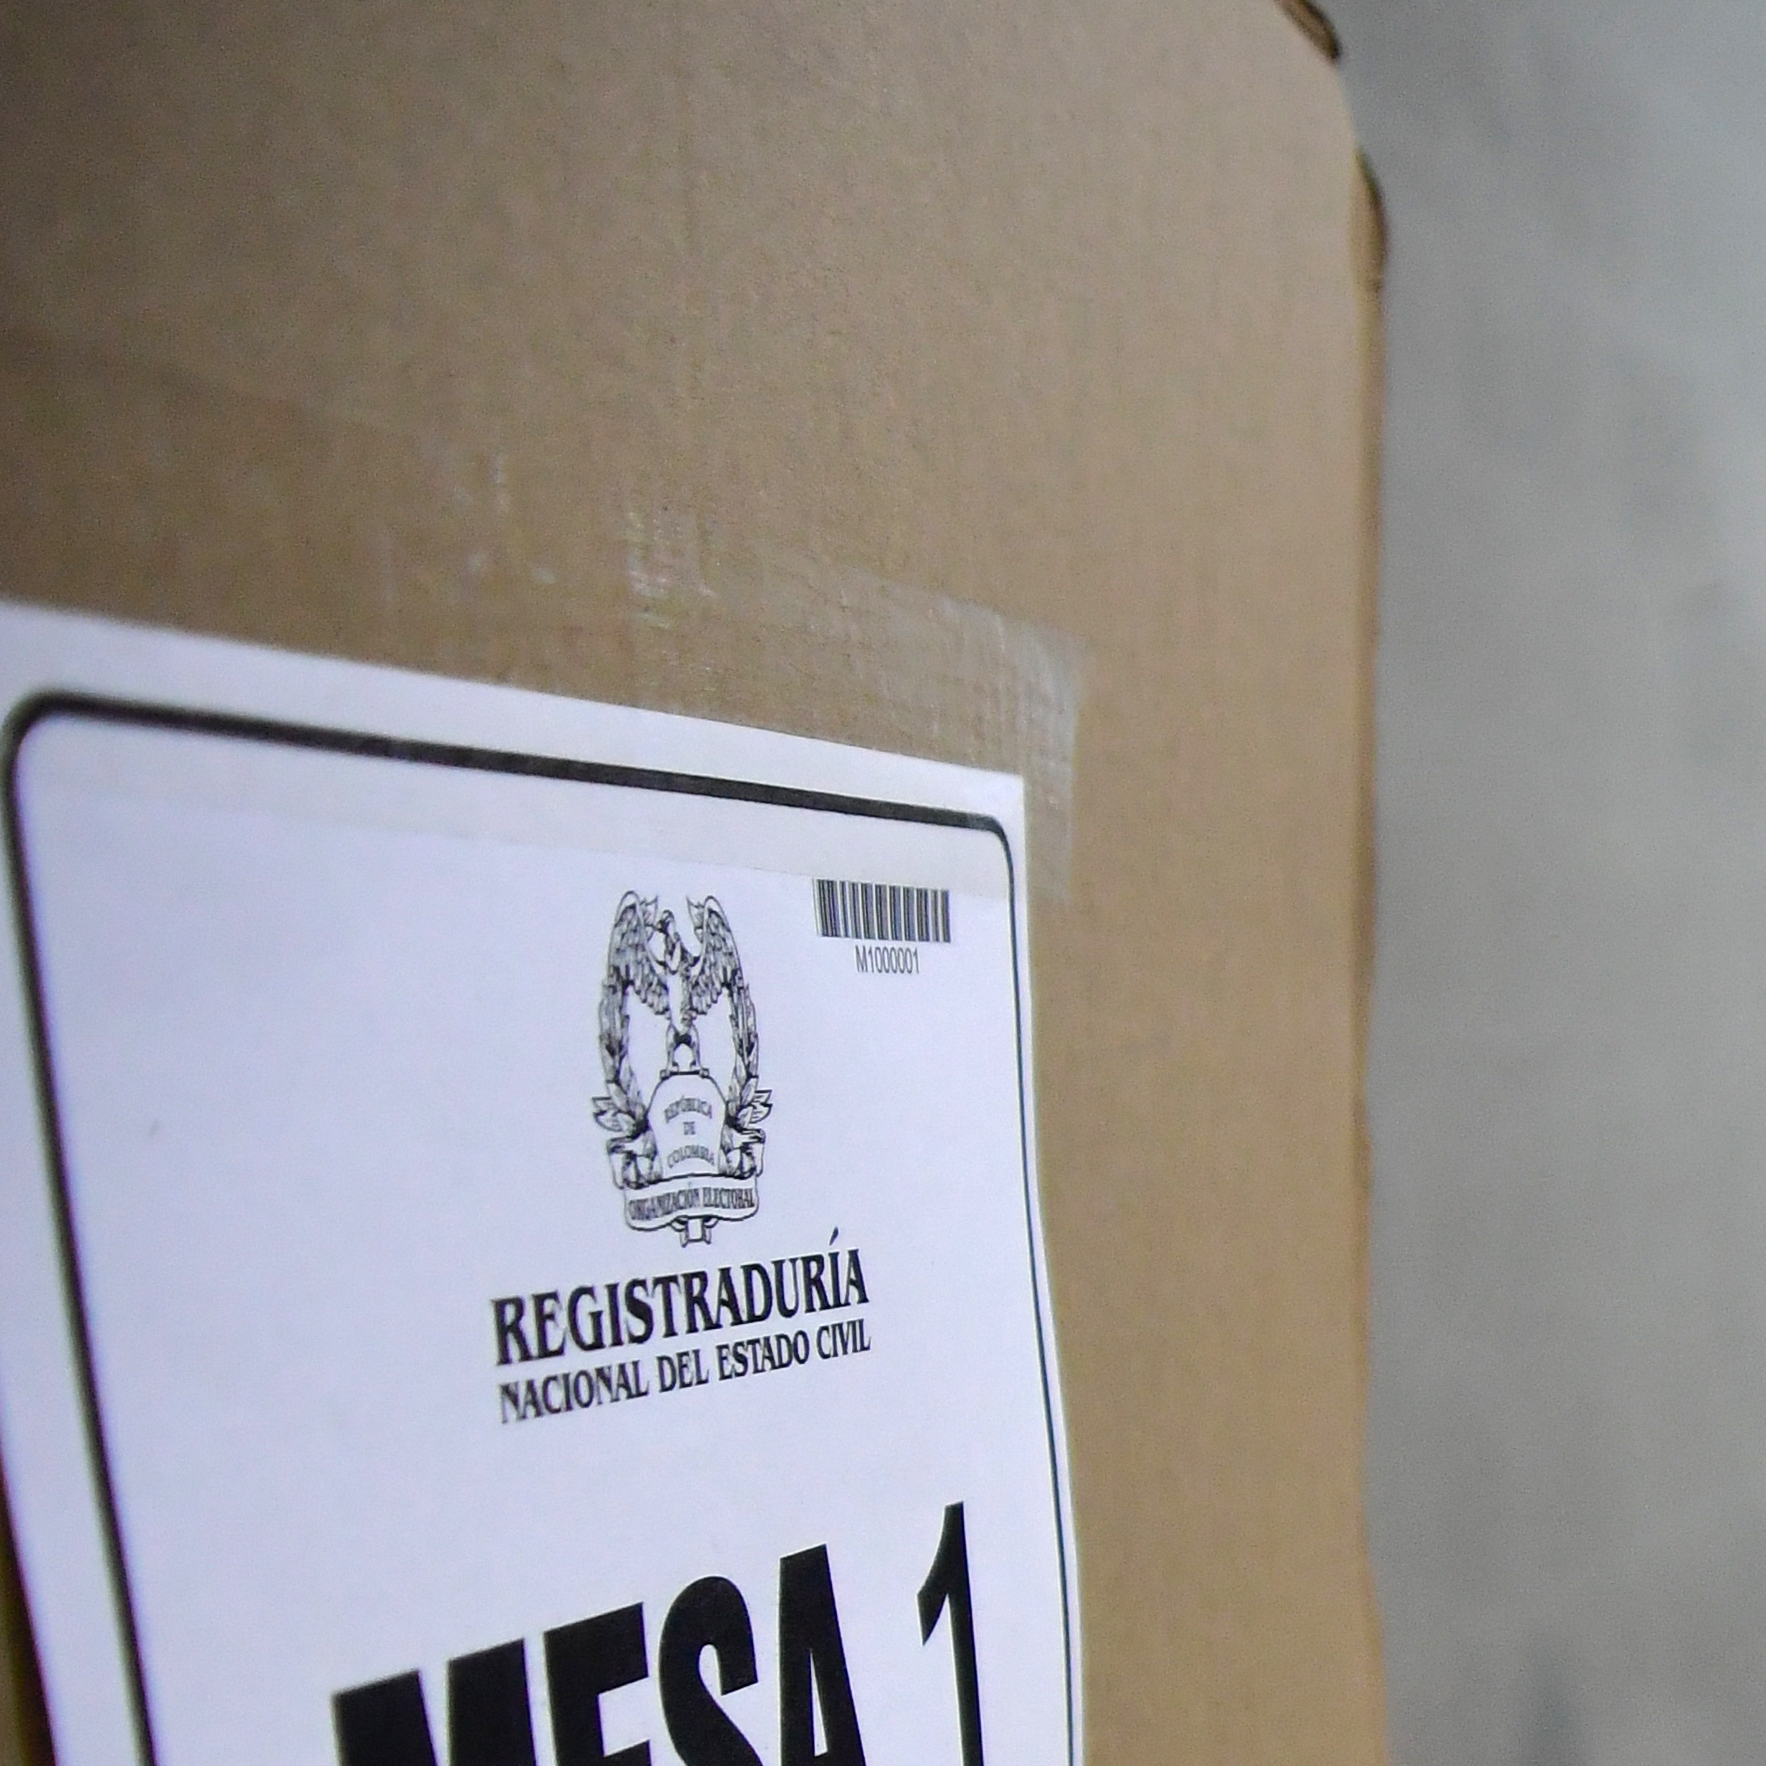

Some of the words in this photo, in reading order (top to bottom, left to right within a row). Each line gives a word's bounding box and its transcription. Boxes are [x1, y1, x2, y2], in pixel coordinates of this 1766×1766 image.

[855, 944, 920, 975] M1000001
[702, 1186, 755, 1210] ELECTORAL
[490, 1226, 870, 1366] REGISTRADURÍA
[499, 1359, 650, 1424] NACIONAL
[655, 1348, 710, 1394] DEL
[716, 1330, 810, 1381] ESTADO
[816, 1317, 872, 1361] CIVIL
